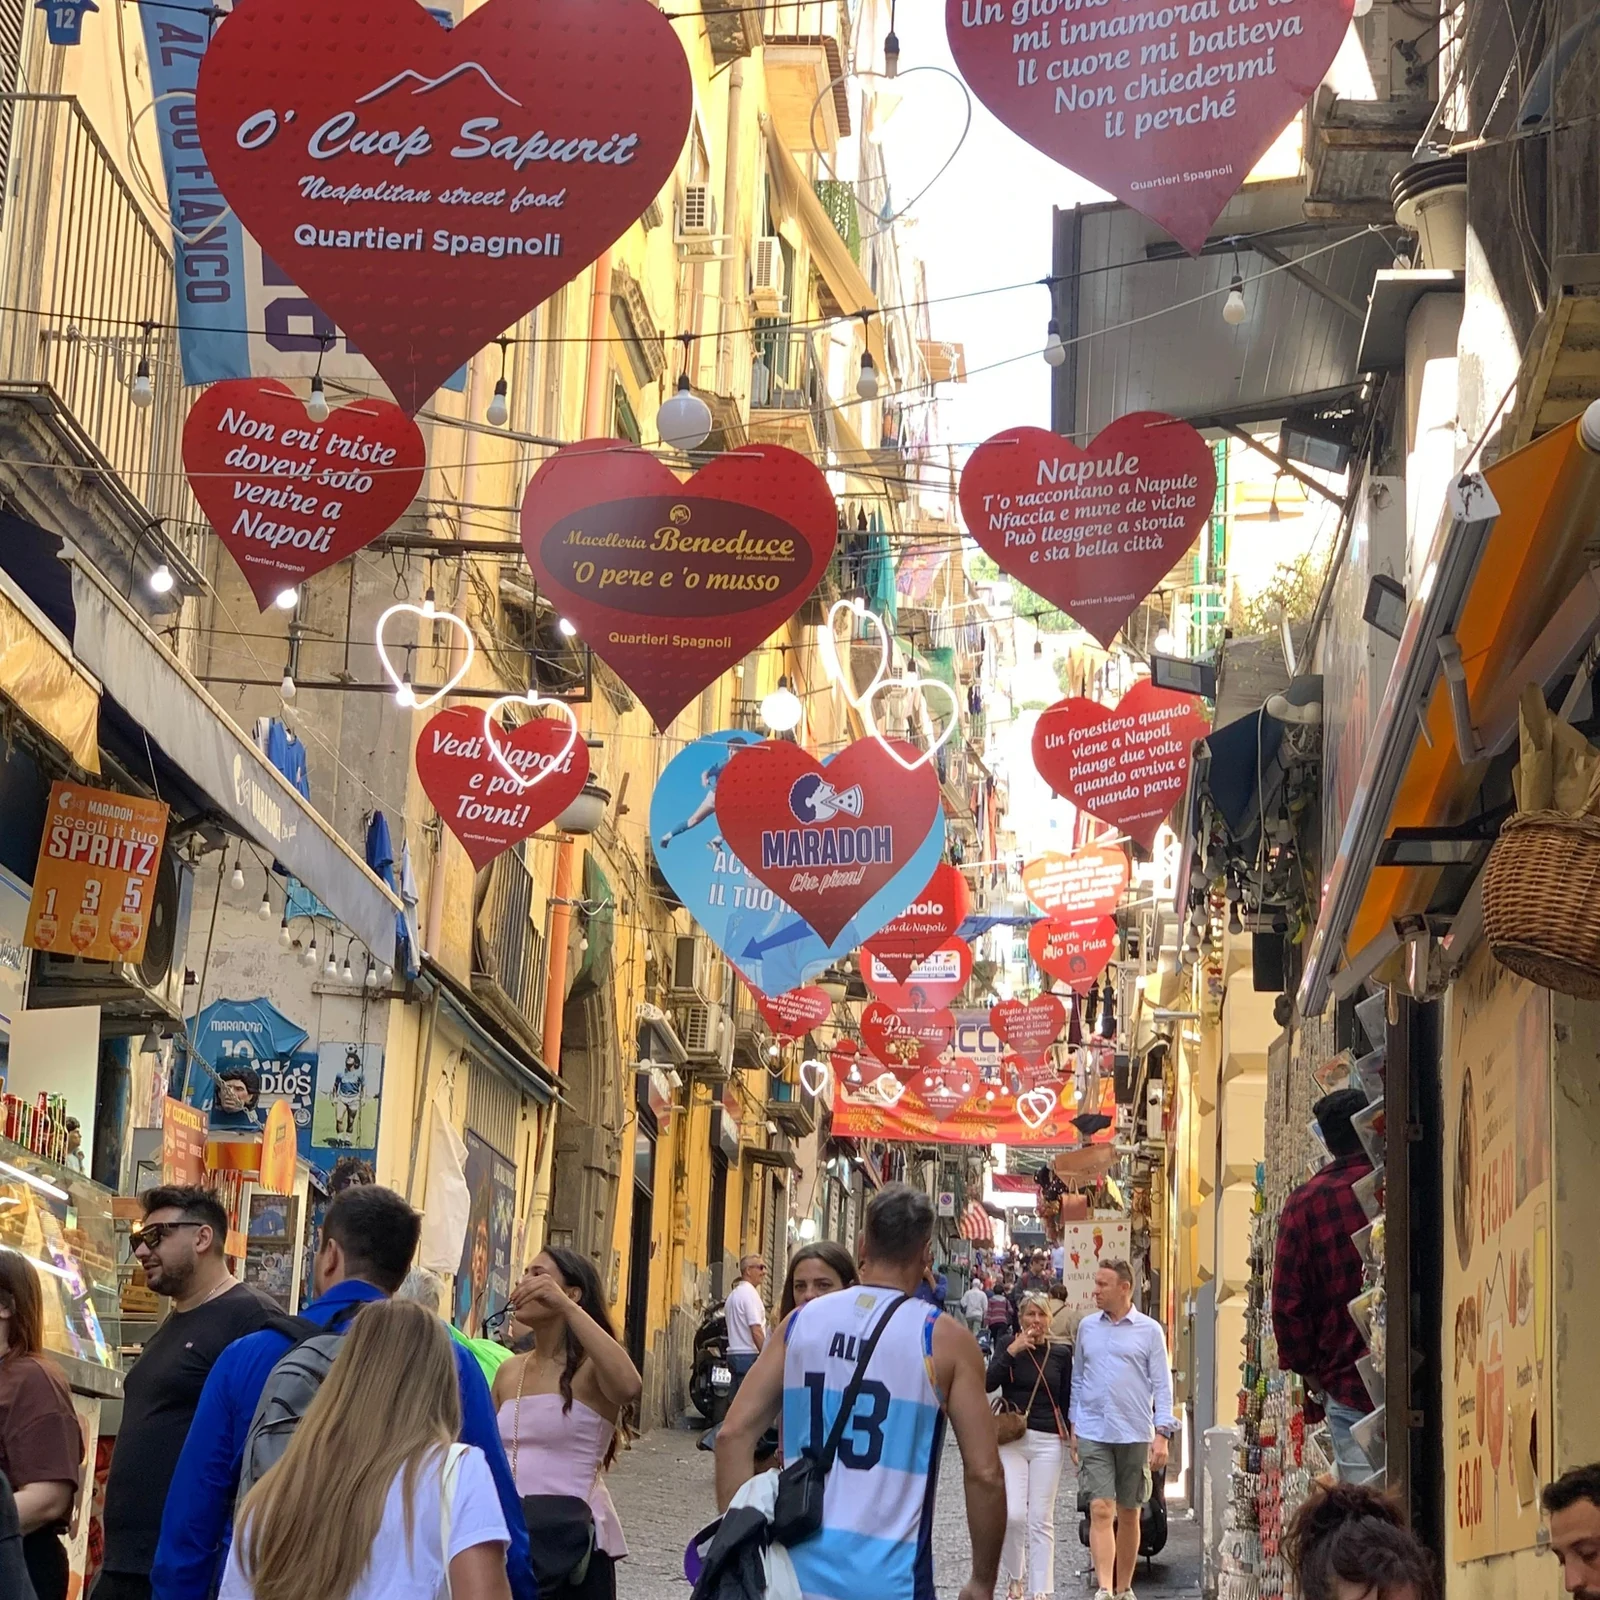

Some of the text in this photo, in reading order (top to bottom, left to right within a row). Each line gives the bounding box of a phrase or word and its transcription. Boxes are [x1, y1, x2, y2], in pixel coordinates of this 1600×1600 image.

[53, 7, 76, 29] 12
[961, 0, 1004, 28] Un
[1012, 1, 1221, 53] mi innamorai
[155, 22, 206, 67] AL
[1017, 15, 1304, 87] Il cuore mi batteva
[1054, 50, 1277, 114] Non chiedermi
[1104, 90, 1238, 139] il perché
[237, 109, 638, 171] O' Cuop Sapurit
[298, 175, 567, 213] Neapolitan street food
[1130, 165, 1233, 191] Quartieri Spagnoli
[174, 165, 231, 304] FIANCO
[294, 223, 562, 257] Quartieri Spagnoli
[217, 407, 398, 466] Non eri triste
[224, 444, 374, 494] dovevi solo
[1036, 451, 1140, 486] Napule
[232, 481, 343, 521] venire a
[1015, 486, 1114, 508] raccontano
[1118, 483, 1131, 494] a
[1135, 474, 1198, 495] Napule
[989, 493, 1197, 532] Nfaccia e mure de viche
[1004, 512, 1186, 548] Può lleggere a storia
[231, 509, 337, 554] Napoli
[562, 525, 796, 556] Macelleria Beneduce
[1029, 533, 1165, 563] e sta bella città
[244, 554, 306, 572] Quartieri Spagnoli
[571, 560, 782, 592] 'O pere e 'o musso
[1069, 593, 1136, 608] Quartieri Spagnoli
[607, 630, 733, 649] Quartieri Spagnoli
[1044, 703, 1191, 750] Un forestiero quando
[1071, 722, 1173, 760] viene a Napoli
[432, 730, 486, 761] Vedi
[1069, 740, 1184, 781] piange due volte
[468, 773, 530, 797] e poi
[1073, 757, 1187, 797] quando arriva e
[1086, 775, 1182, 810] quando parte
[86, 800, 134, 823] MARADOH
[455, 794, 532, 829] Torni!
[52, 814, 108, 837] scegli
[130, 828, 160, 846] tuo
[761, 825, 894, 869] MARADOH
[48, 825, 156, 877] SPRITZ
[45, 876, 144, 916] 1 3 5
[708, 883, 726, 907] IL
[733, 885, 774, 912] TUO
[913, 921, 948, 934] Napoli
[902, 952, 925, 960] Spanoli
[1066, 942, 1080, 956] De
[210, 1019, 264, 1033] MARADONA
[870, 1009, 882, 1024] da
[221, 1039, 255, 1059] 10
[828, 1331, 866, 1363] AL
[803, 1371, 891, 1471] 13
